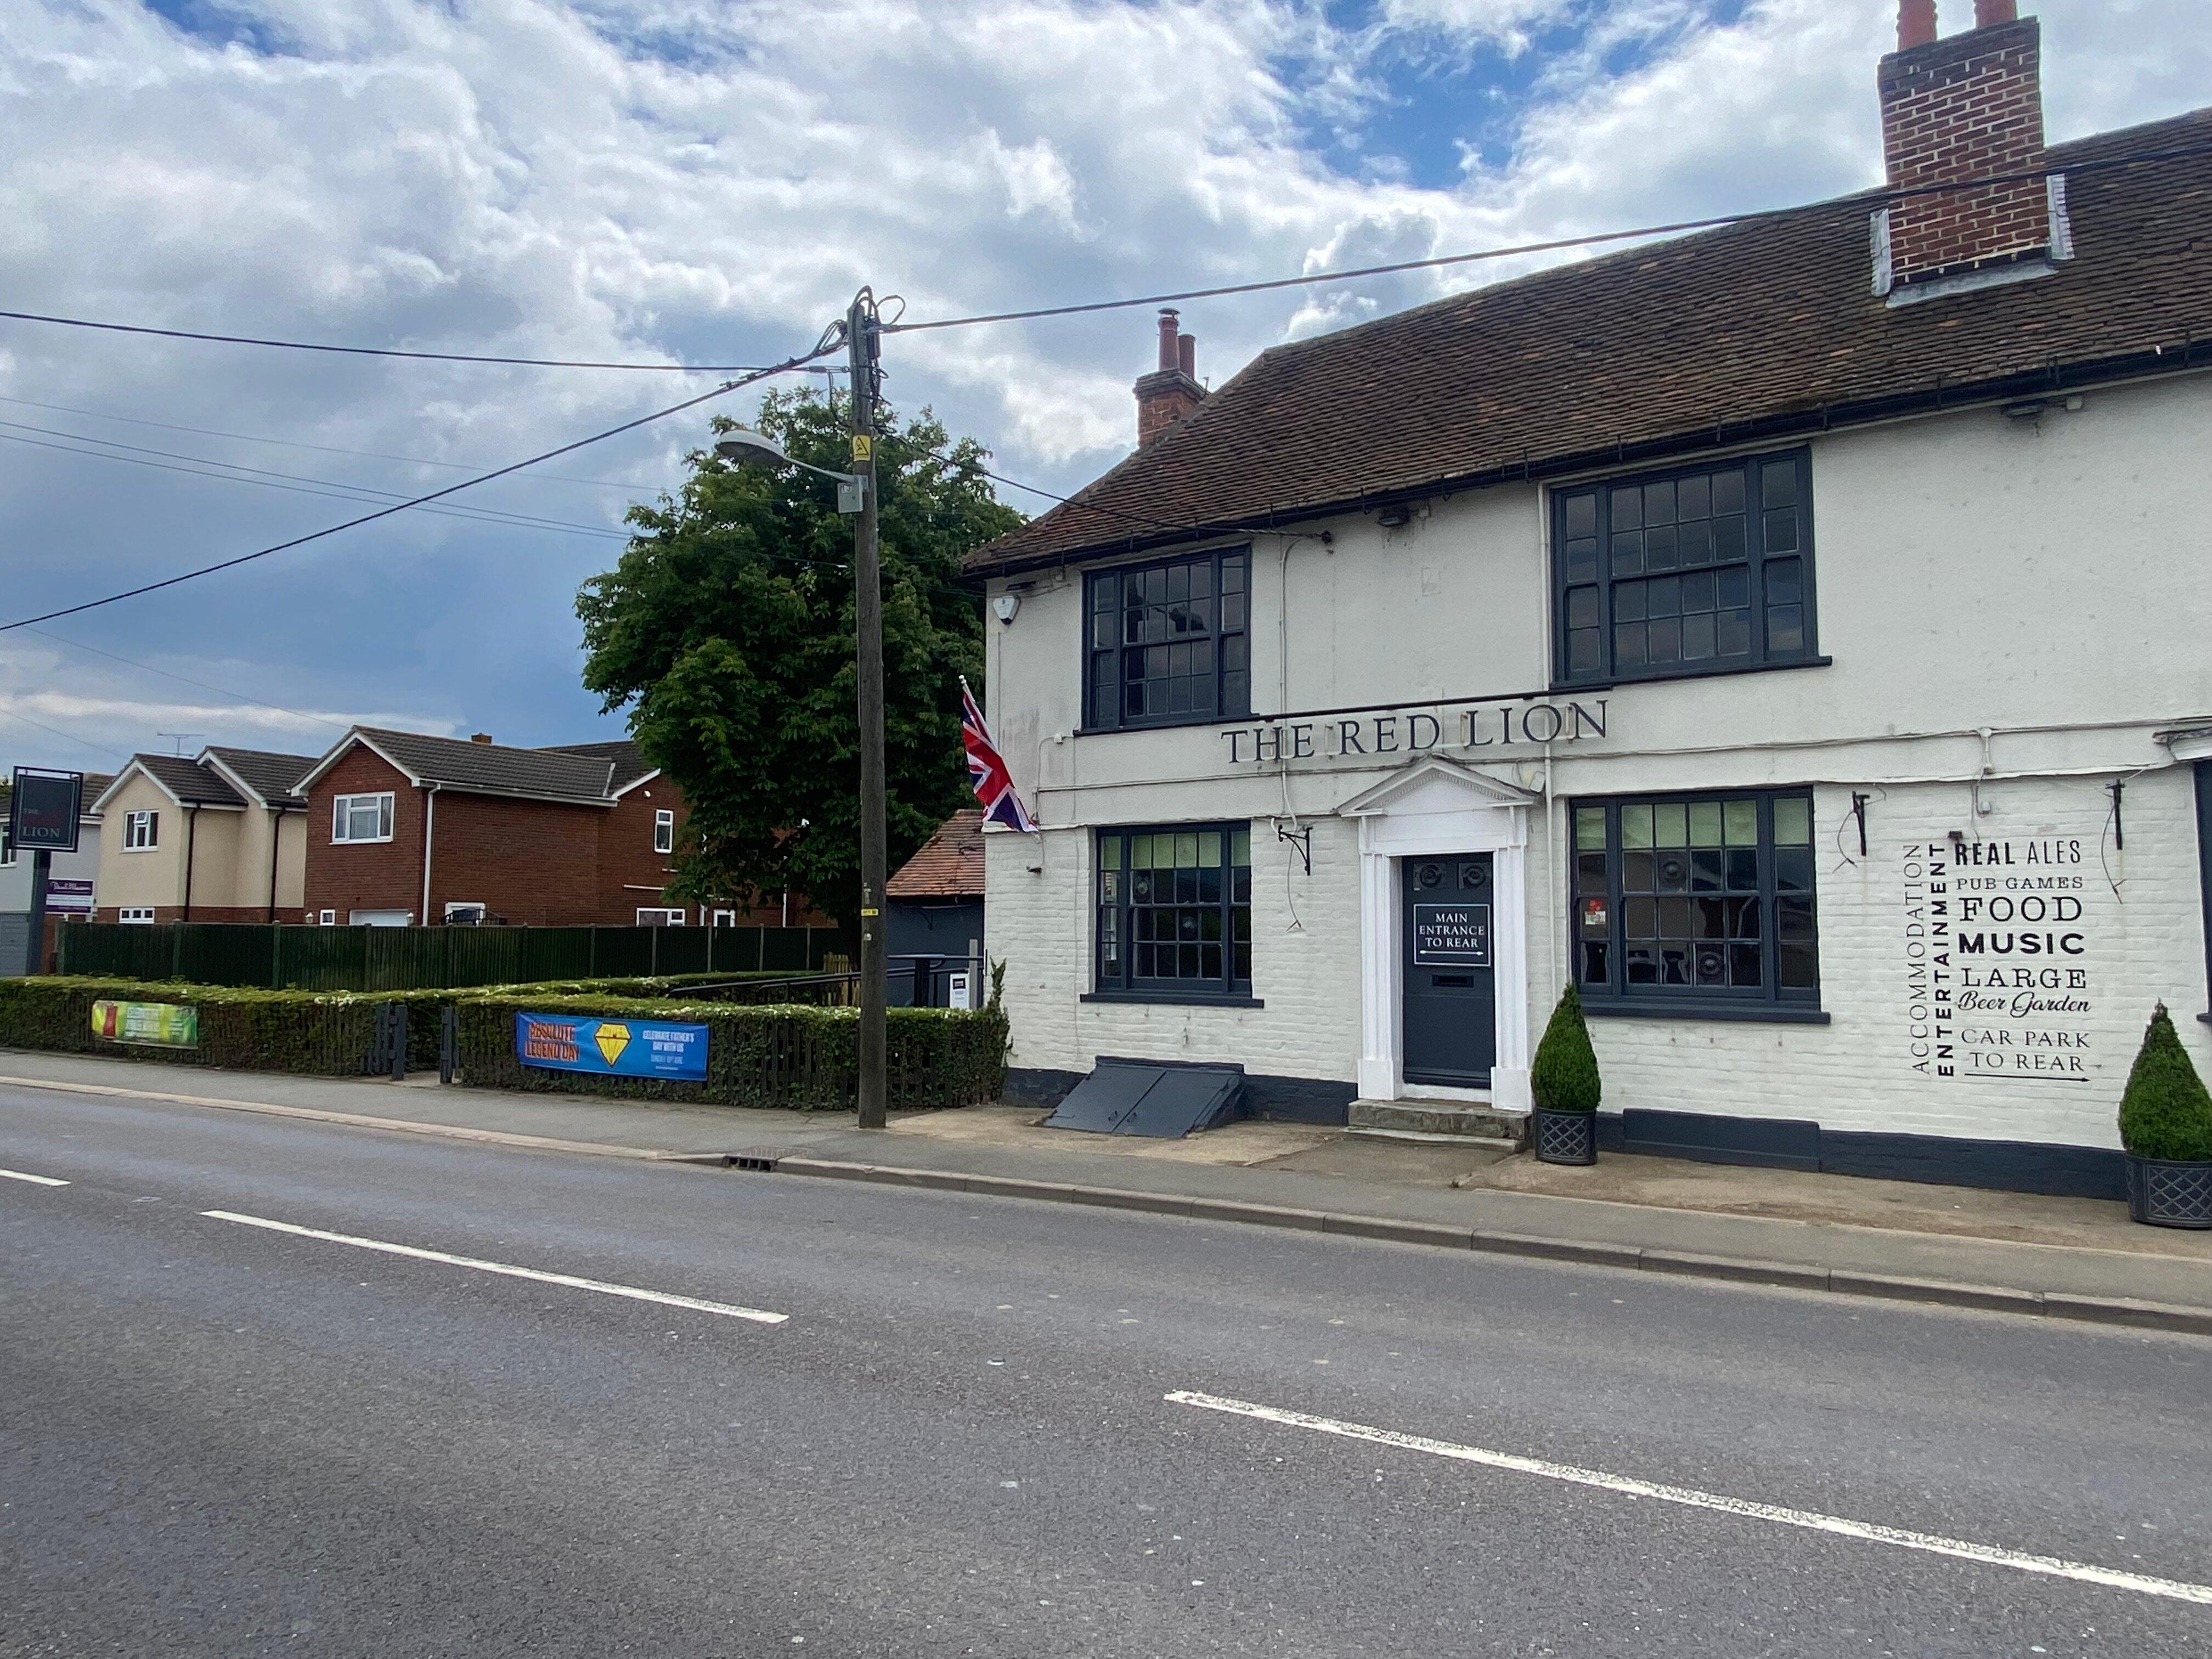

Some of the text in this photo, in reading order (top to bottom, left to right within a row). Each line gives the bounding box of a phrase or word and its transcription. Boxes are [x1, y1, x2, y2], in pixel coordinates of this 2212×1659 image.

[1221, 700, 1609, 764] THE RED LION
[22, 826, 60, 838] LION
[1955, 840, 2081, 866] REAL ALES
[1957, 876, 2083, 890] PUB GAMES
[1435, 913, 1468, 923] MAIN
[1959, 896, 2082, 922] FOOD
[1419, 925, 1485, 935] ENTRANCE
[1425, 938, 1478, 947] TO REAR
[1959, 933, 2085, 954] MUSIC
[1903, 845, 1930, 1074] ACCOMMODATION
[1929, 844, 1954, 1077] ENTERTAINMENT
[1961, 968, 2086, 989] LARGE
[1957, 991, 2091, 1018] Beer Garden
[529, 1023, 576, 1042] ABSOLUTE
[1961, 1029, 2090, 1048] CAR PARK
[525, 1040, 579, 1062] LEGEND DAY
[1969, 1052, 2084, 1071] TO REAR
